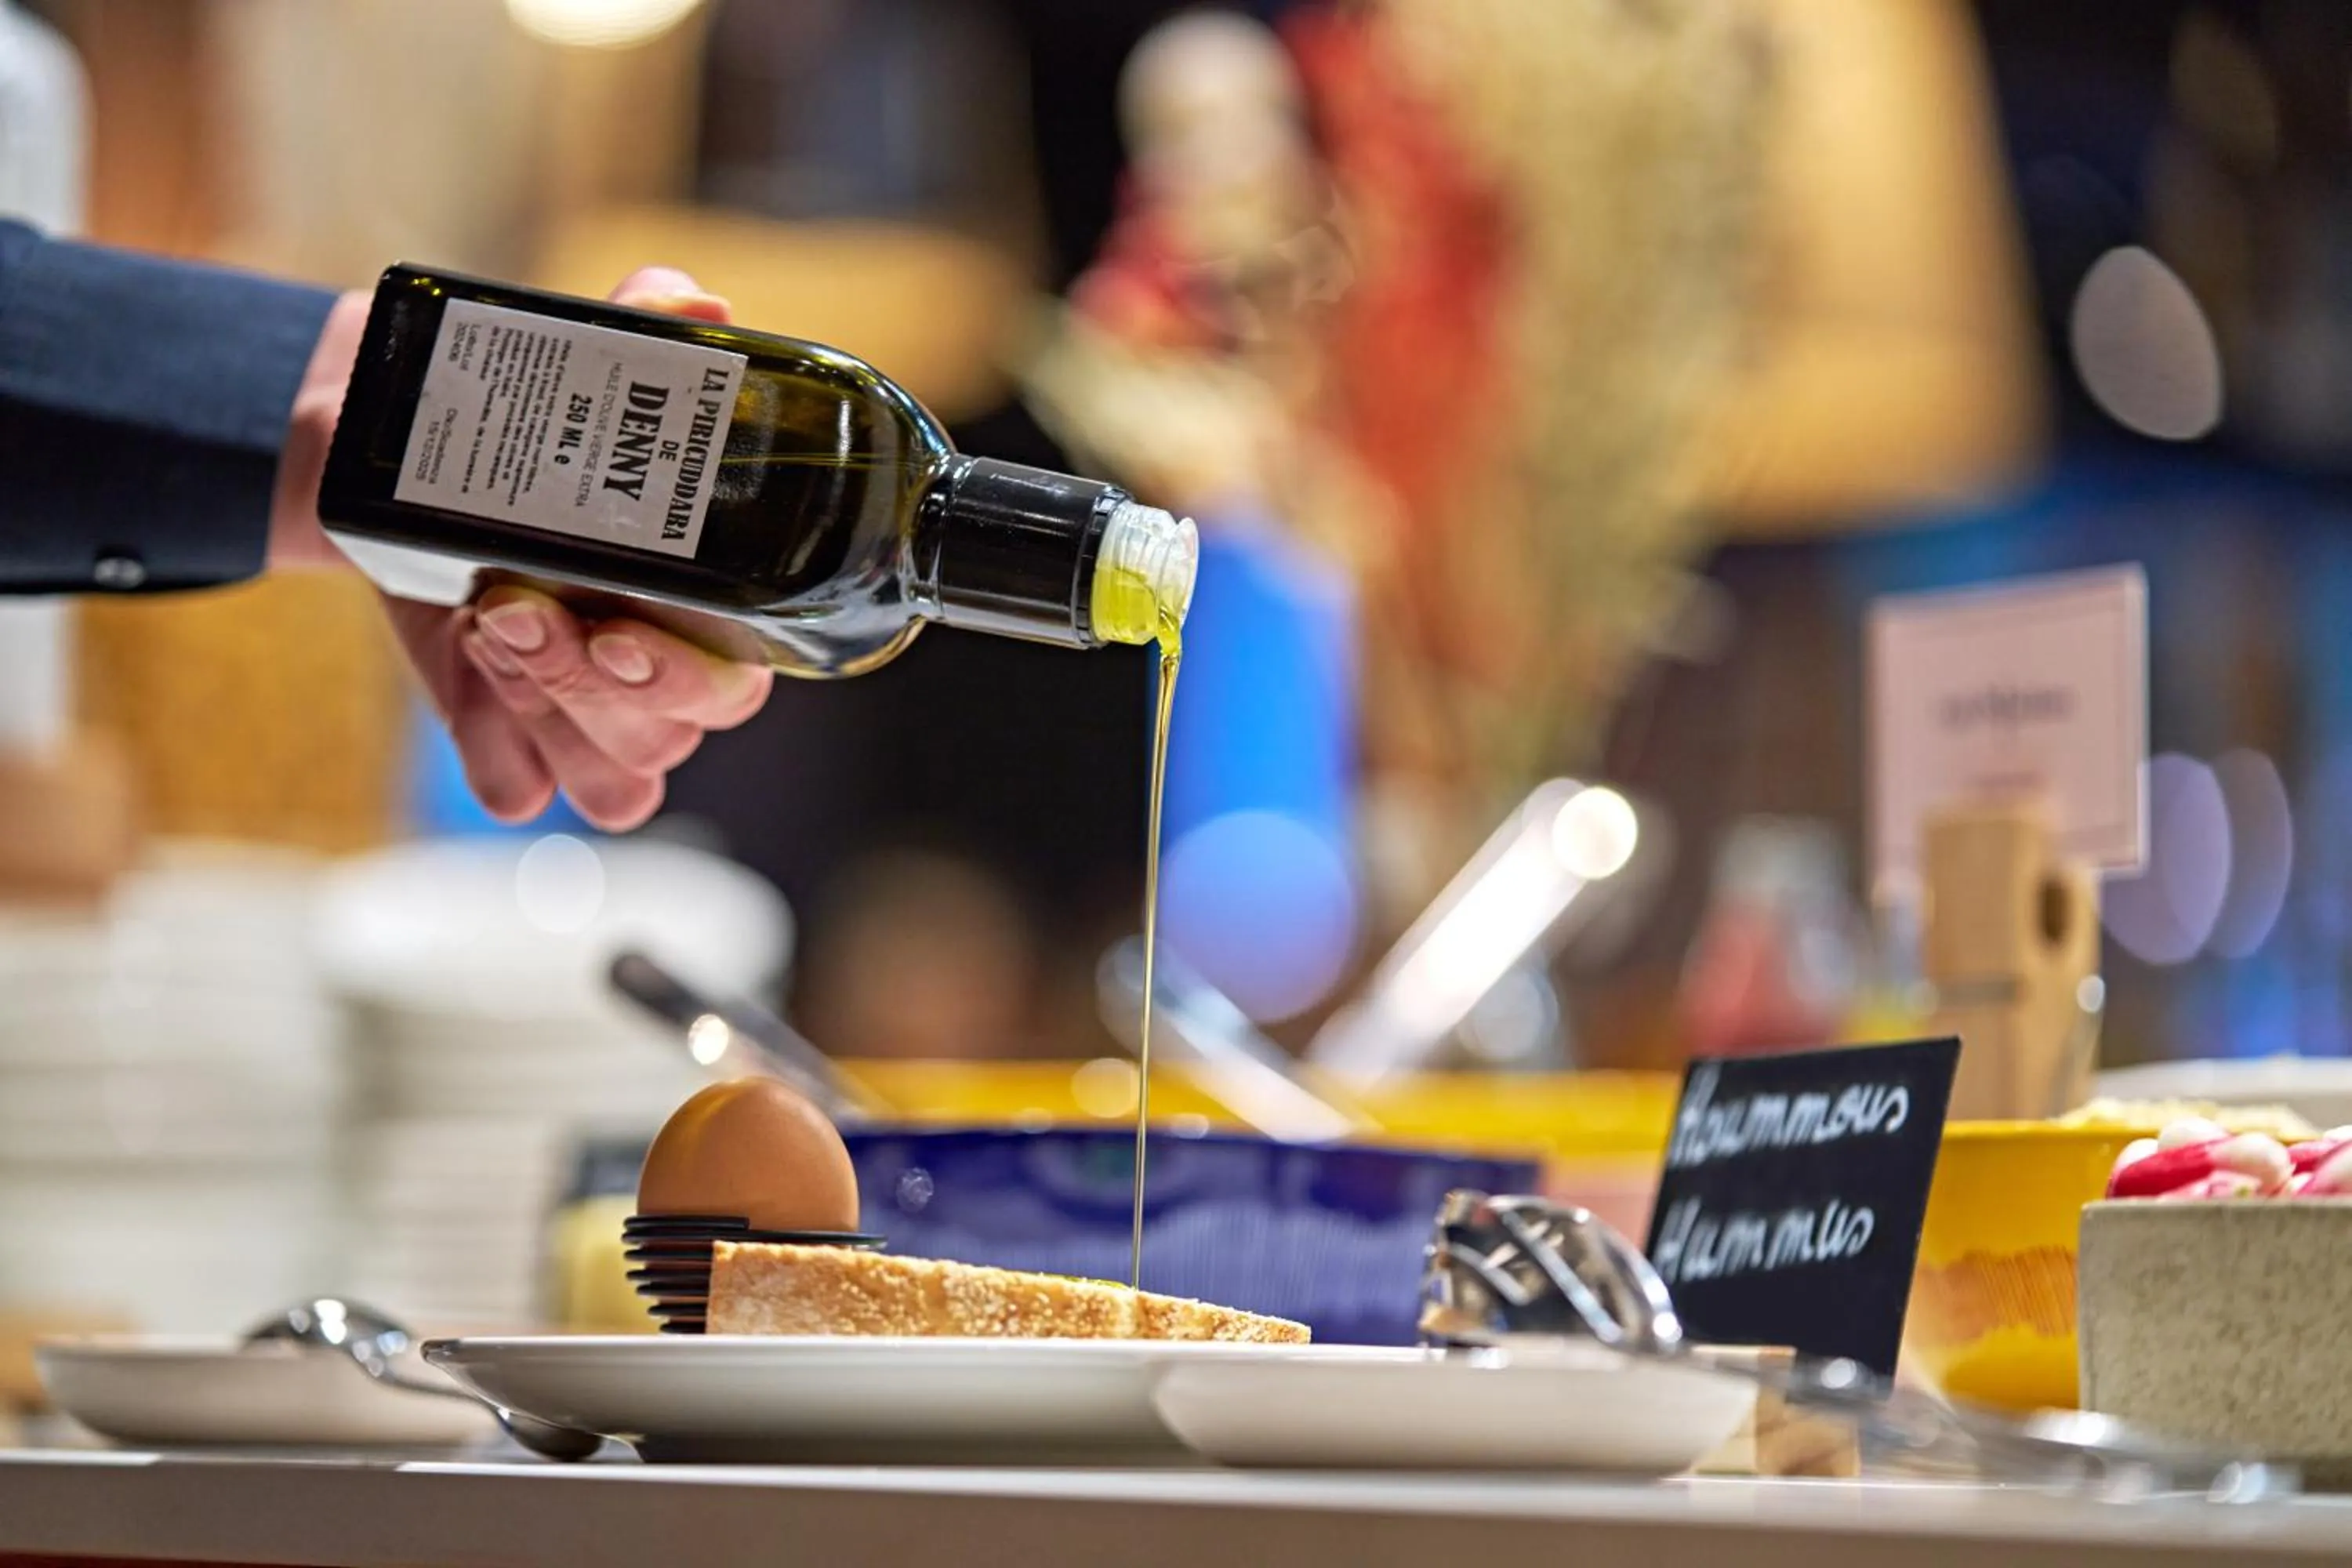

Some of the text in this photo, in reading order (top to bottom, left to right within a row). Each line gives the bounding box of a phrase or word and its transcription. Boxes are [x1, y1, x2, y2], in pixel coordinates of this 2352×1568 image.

[604, 361, 622, 392] HUILE
[565, 392, 593, 423] 250
[557, 426, 583, 449] ML
[582, 434, 602, 472] VIERGE
[603, 382, 668, 499] DENNY
[657, 439, 680, 462] DE
[661, 367, 729, 539] LA PIRICUDDARA
[574, 473, 593, 507] EXTRA
